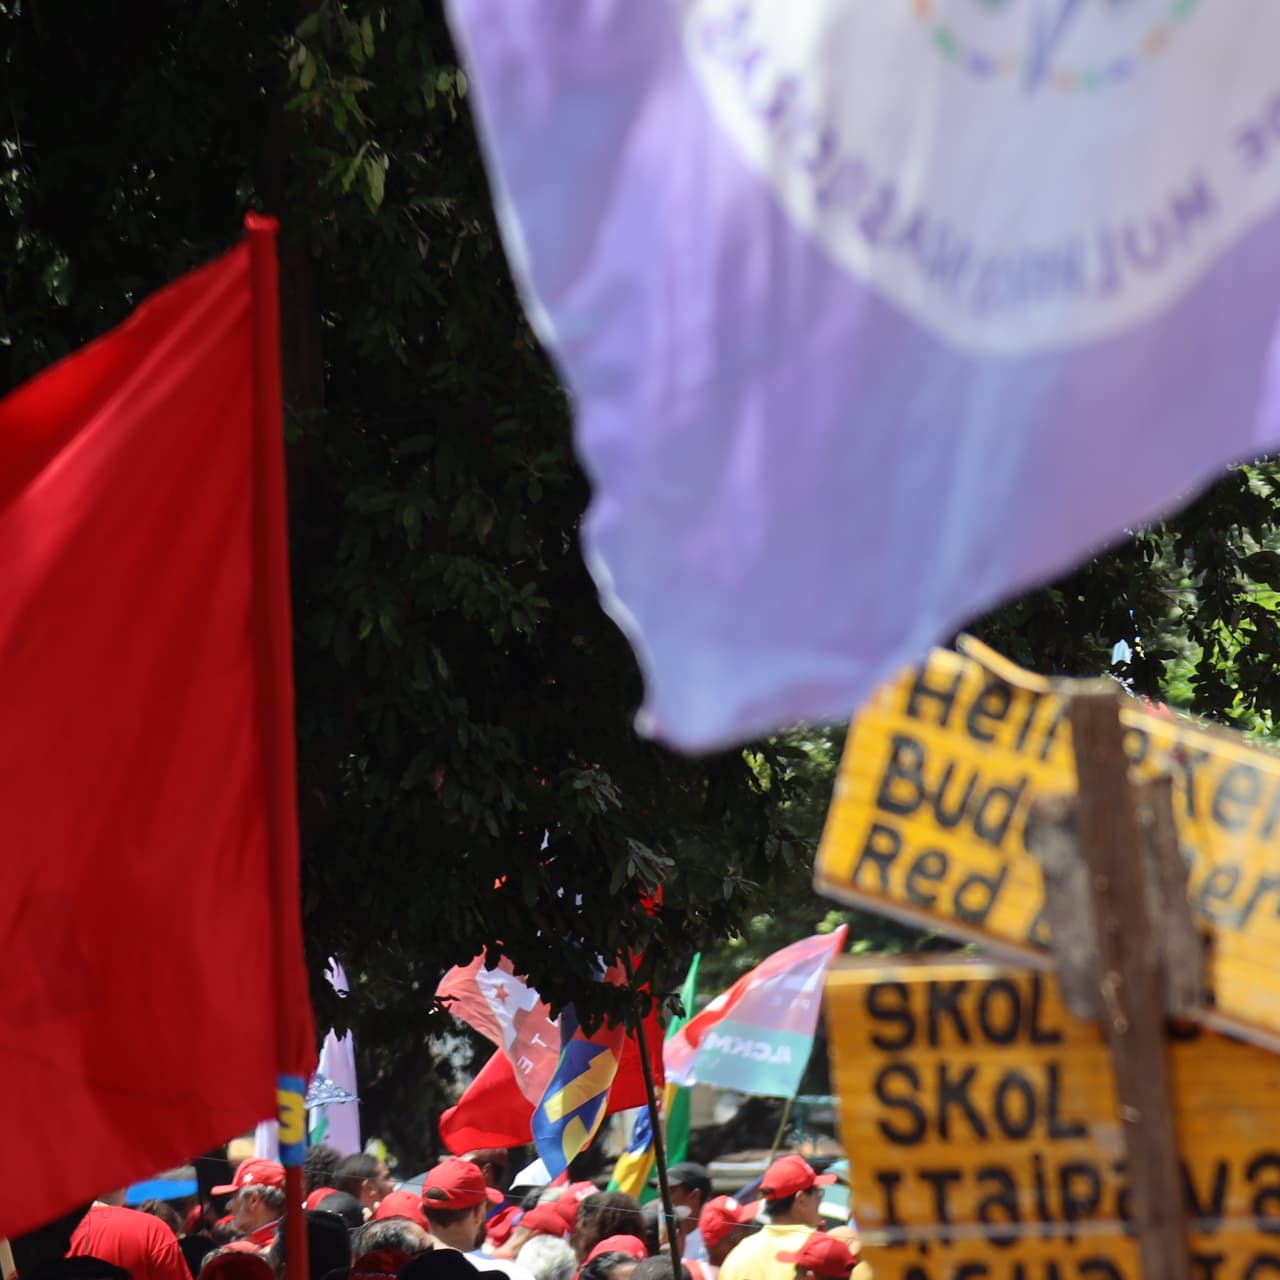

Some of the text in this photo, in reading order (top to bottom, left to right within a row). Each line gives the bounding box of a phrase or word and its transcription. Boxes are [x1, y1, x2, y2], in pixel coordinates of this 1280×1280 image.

[854, 821, 1008, 924] Red
[865, 972, 1063, 1053] SKOL
[874, 1060, 1087, 1146] SKOL
